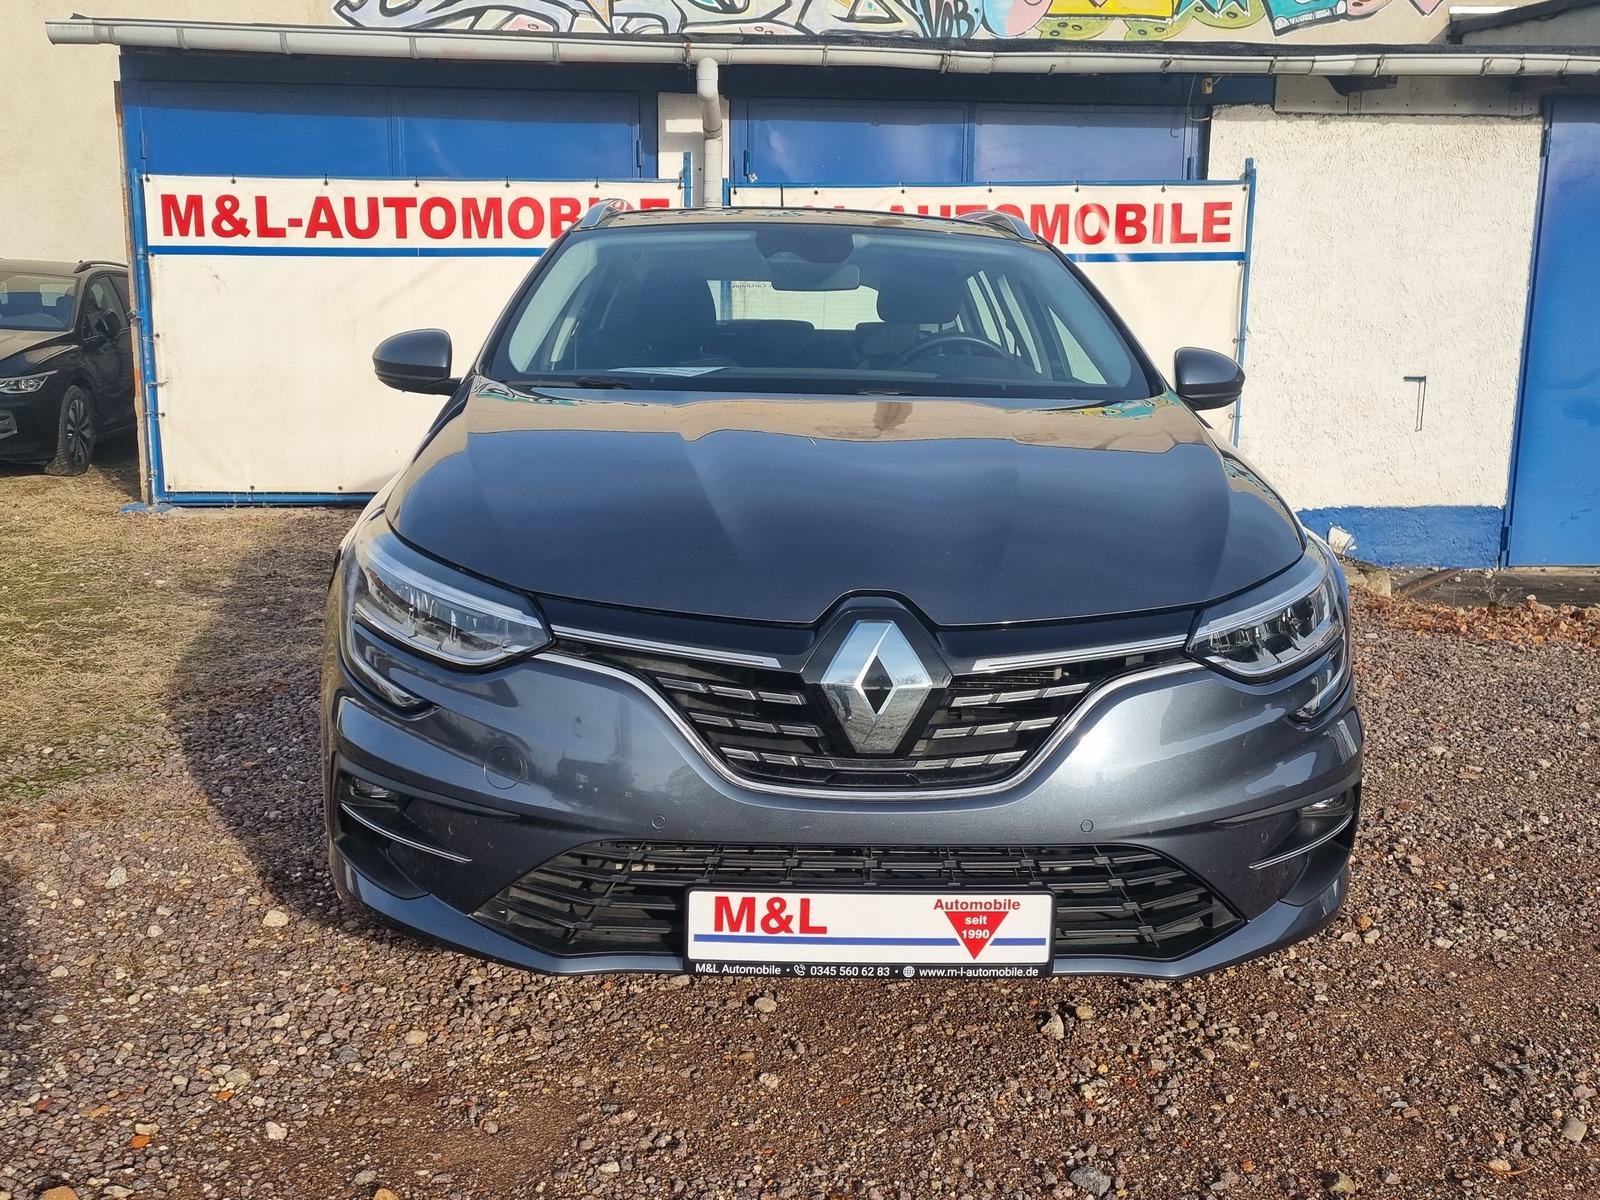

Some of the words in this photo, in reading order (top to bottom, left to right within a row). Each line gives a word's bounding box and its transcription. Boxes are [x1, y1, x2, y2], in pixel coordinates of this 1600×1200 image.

[160, 193, 670, 240] M&L-AUTOMOB
[934, 899, 1021, 911] Automobile
[714, 896, 828, 935] M&L
[964, 915, 988, 925] seit
[961, 929, 990, 939] 1990
[695, 963, 720, 973] M&L
[722, 964, 781, 975] Automobile
[810, 966, 836, 976] 0345
[839, 966, 860, 976] 560
[861, 966, 875, 976] 62
[876, 967, 890, 977] 83
[919, 967, 1039, 977] www.m-l-automobile.de
